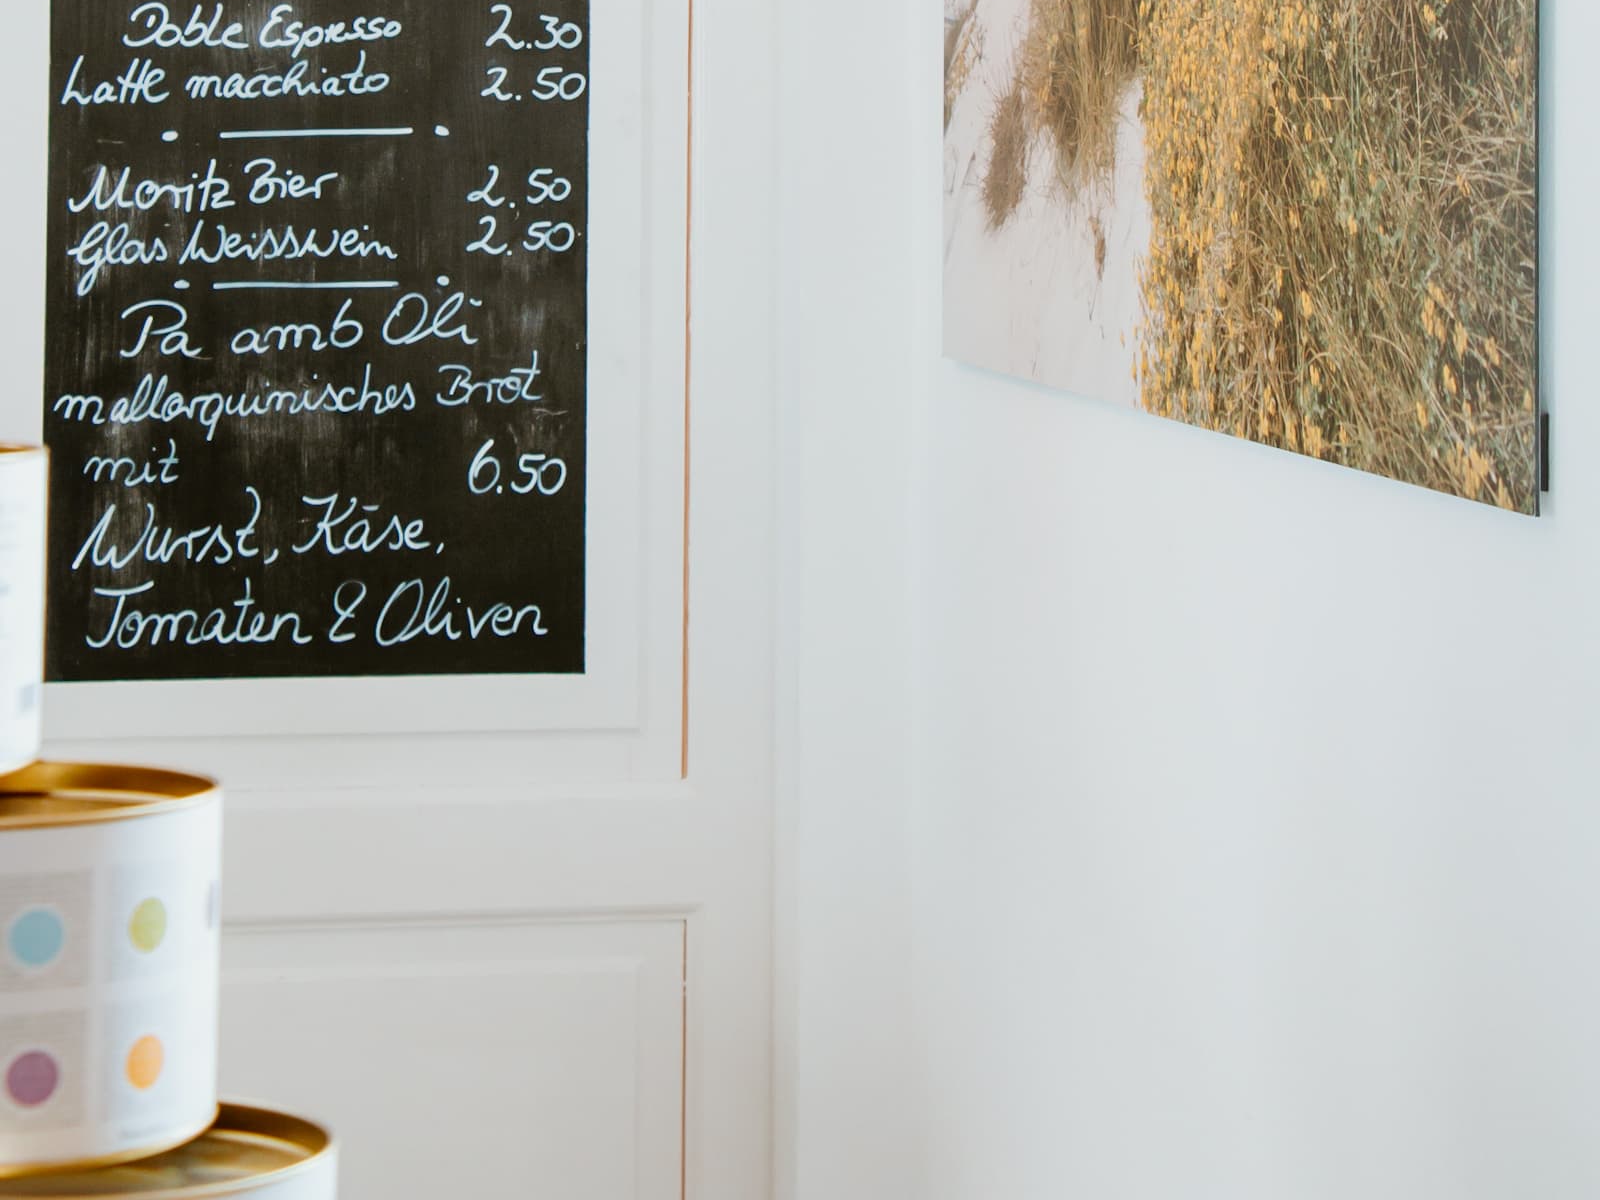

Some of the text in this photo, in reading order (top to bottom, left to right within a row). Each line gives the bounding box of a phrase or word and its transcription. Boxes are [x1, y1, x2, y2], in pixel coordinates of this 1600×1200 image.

[123, 2, 583, 57] Doble Espresso 2.30
[61, 55, 169, 104] Latte
[186, 49, 390, 99] macchiato
[68, 158, 236, 212] Moritz
[244, 157, 338, 203] Bier
[67, 222, 166, 296] Glas
[178, 220, 398, 264] Weisswein
[120, 291, 481, 358] Pa amb Oli
[54, 350, 542, 441] mallorquinisches Brot
[83, 438, 567, 495] mit 6.50
[72, 486, 278, 569] Wurst,
[86, 577, 311, 648] Tomaten
[375, 576, 548, 646] Oliven
